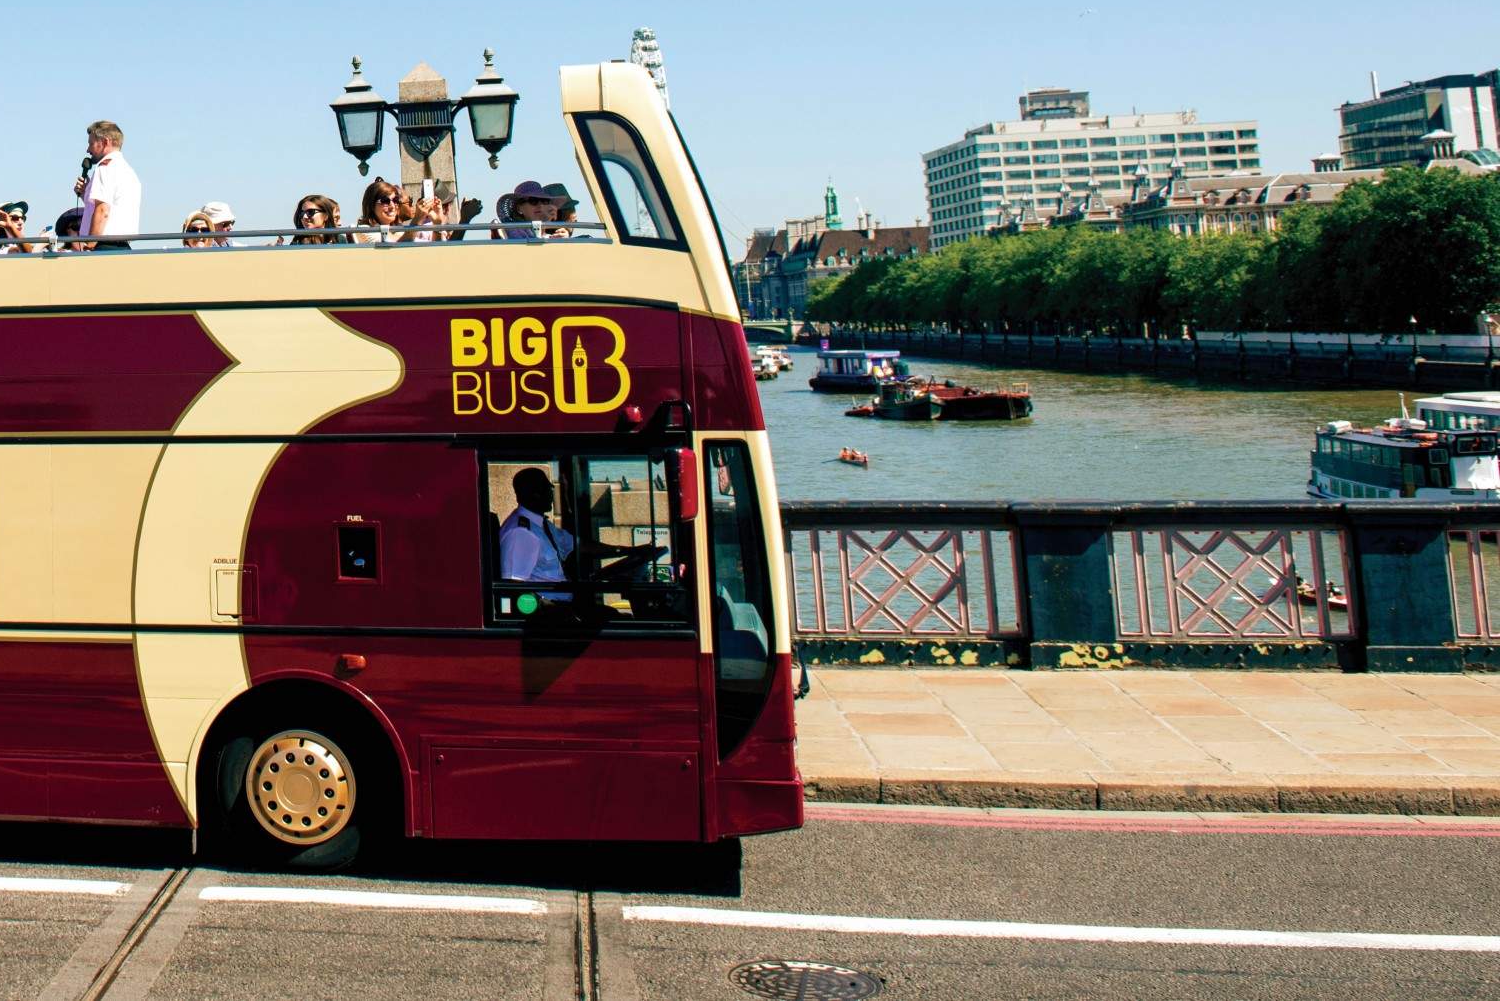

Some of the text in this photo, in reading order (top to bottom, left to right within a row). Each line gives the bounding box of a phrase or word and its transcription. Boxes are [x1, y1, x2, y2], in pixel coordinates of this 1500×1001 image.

[451, 316, 547, 367] BIG
[452, 370, 550, 415] BUS
[346, 514, 364, 522] FUEL
